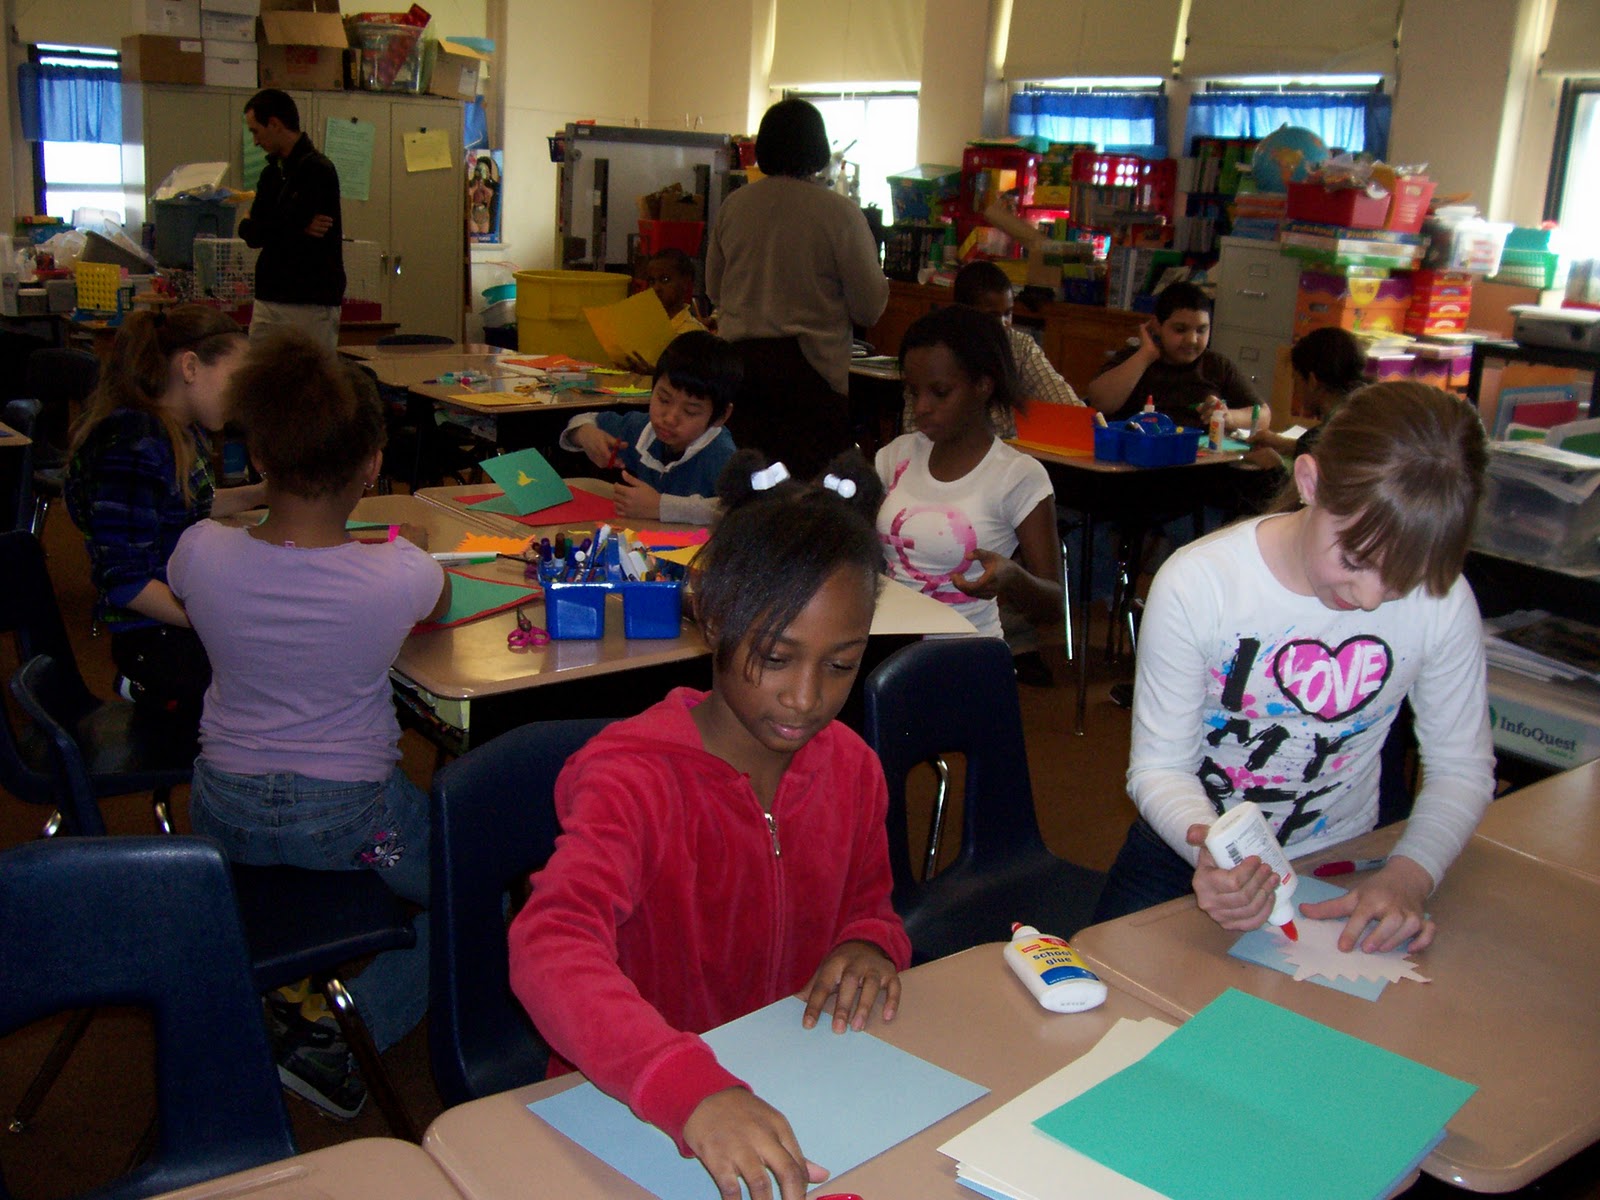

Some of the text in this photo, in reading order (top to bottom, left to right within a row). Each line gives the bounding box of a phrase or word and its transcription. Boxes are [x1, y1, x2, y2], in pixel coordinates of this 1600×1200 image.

[1221, 637, 1386, 714] I LOVE
[1206, 717, 1368, 783] MY
[1500, 716, 1577, 752] InfoQuest
[1032, 950, 1073, 960] school
[1045, 956, 1073, 965] glue
